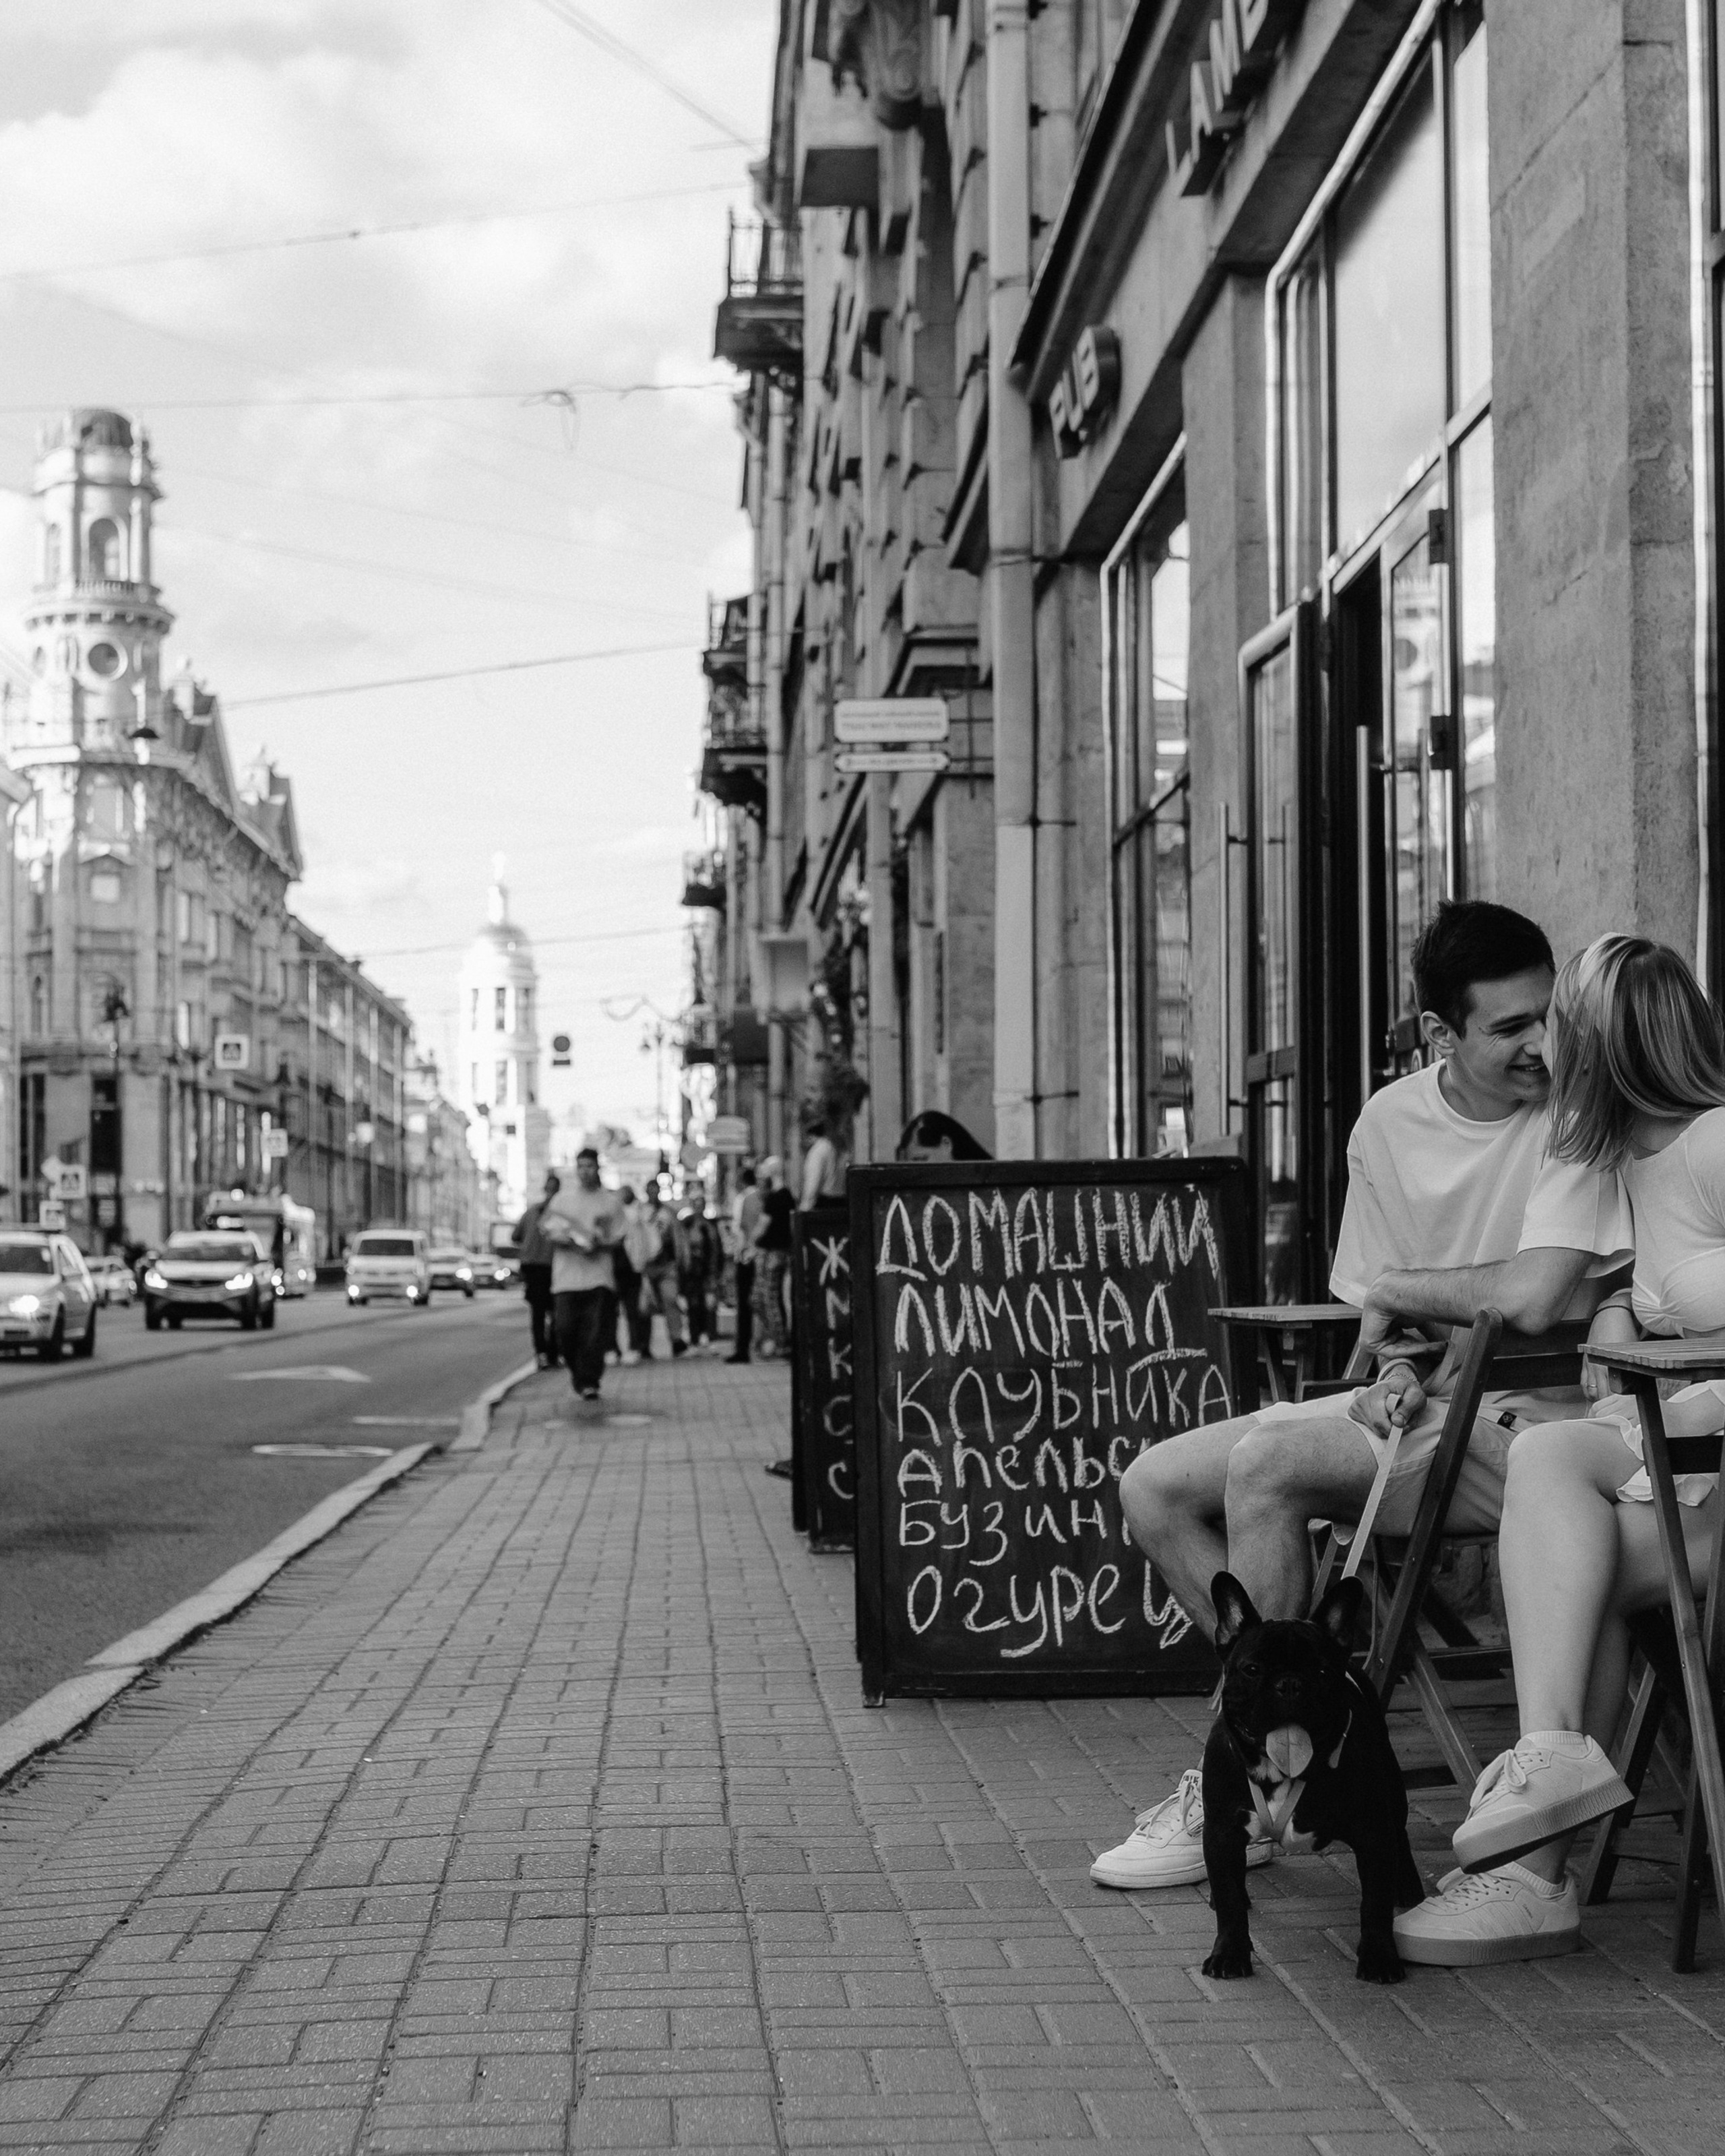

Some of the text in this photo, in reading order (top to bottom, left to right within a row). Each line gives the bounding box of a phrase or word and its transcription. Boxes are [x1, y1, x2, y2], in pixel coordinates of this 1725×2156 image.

[1049, 325, 1100, 460] PUB
[894, 1276, 1208, 1376] ЛИМОНАД
[896, 1359, 1232, 1446] КЛУБНИКА
